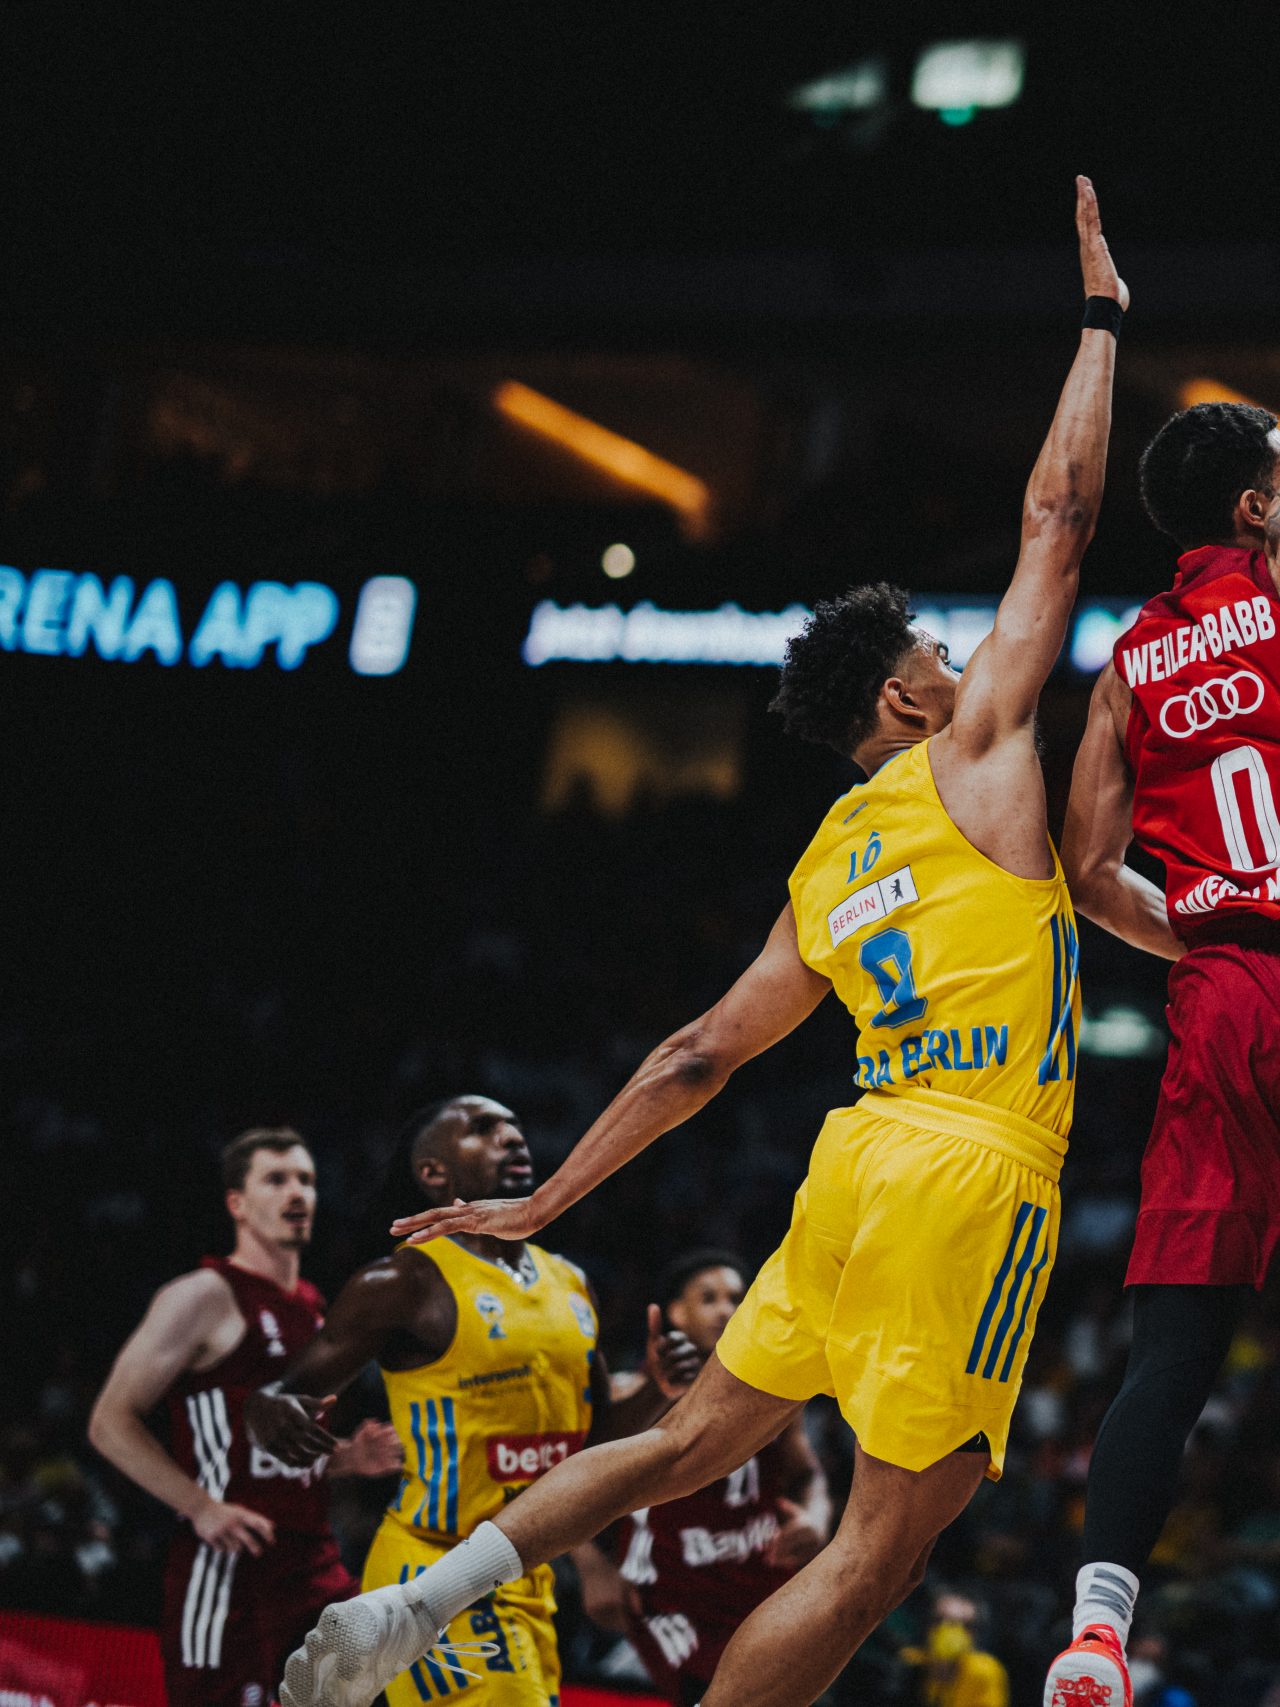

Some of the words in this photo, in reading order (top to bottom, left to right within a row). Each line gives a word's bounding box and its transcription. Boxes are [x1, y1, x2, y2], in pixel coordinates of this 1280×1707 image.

[189, 579, 339, 670] APP
[1122, 595, 1276, 689] WEILERBABB
[846, 831, 882, 885] LÔ
[832, 896, 877, 935] BERLIN
[900, 1024, 1008, 1078] BERLIN
